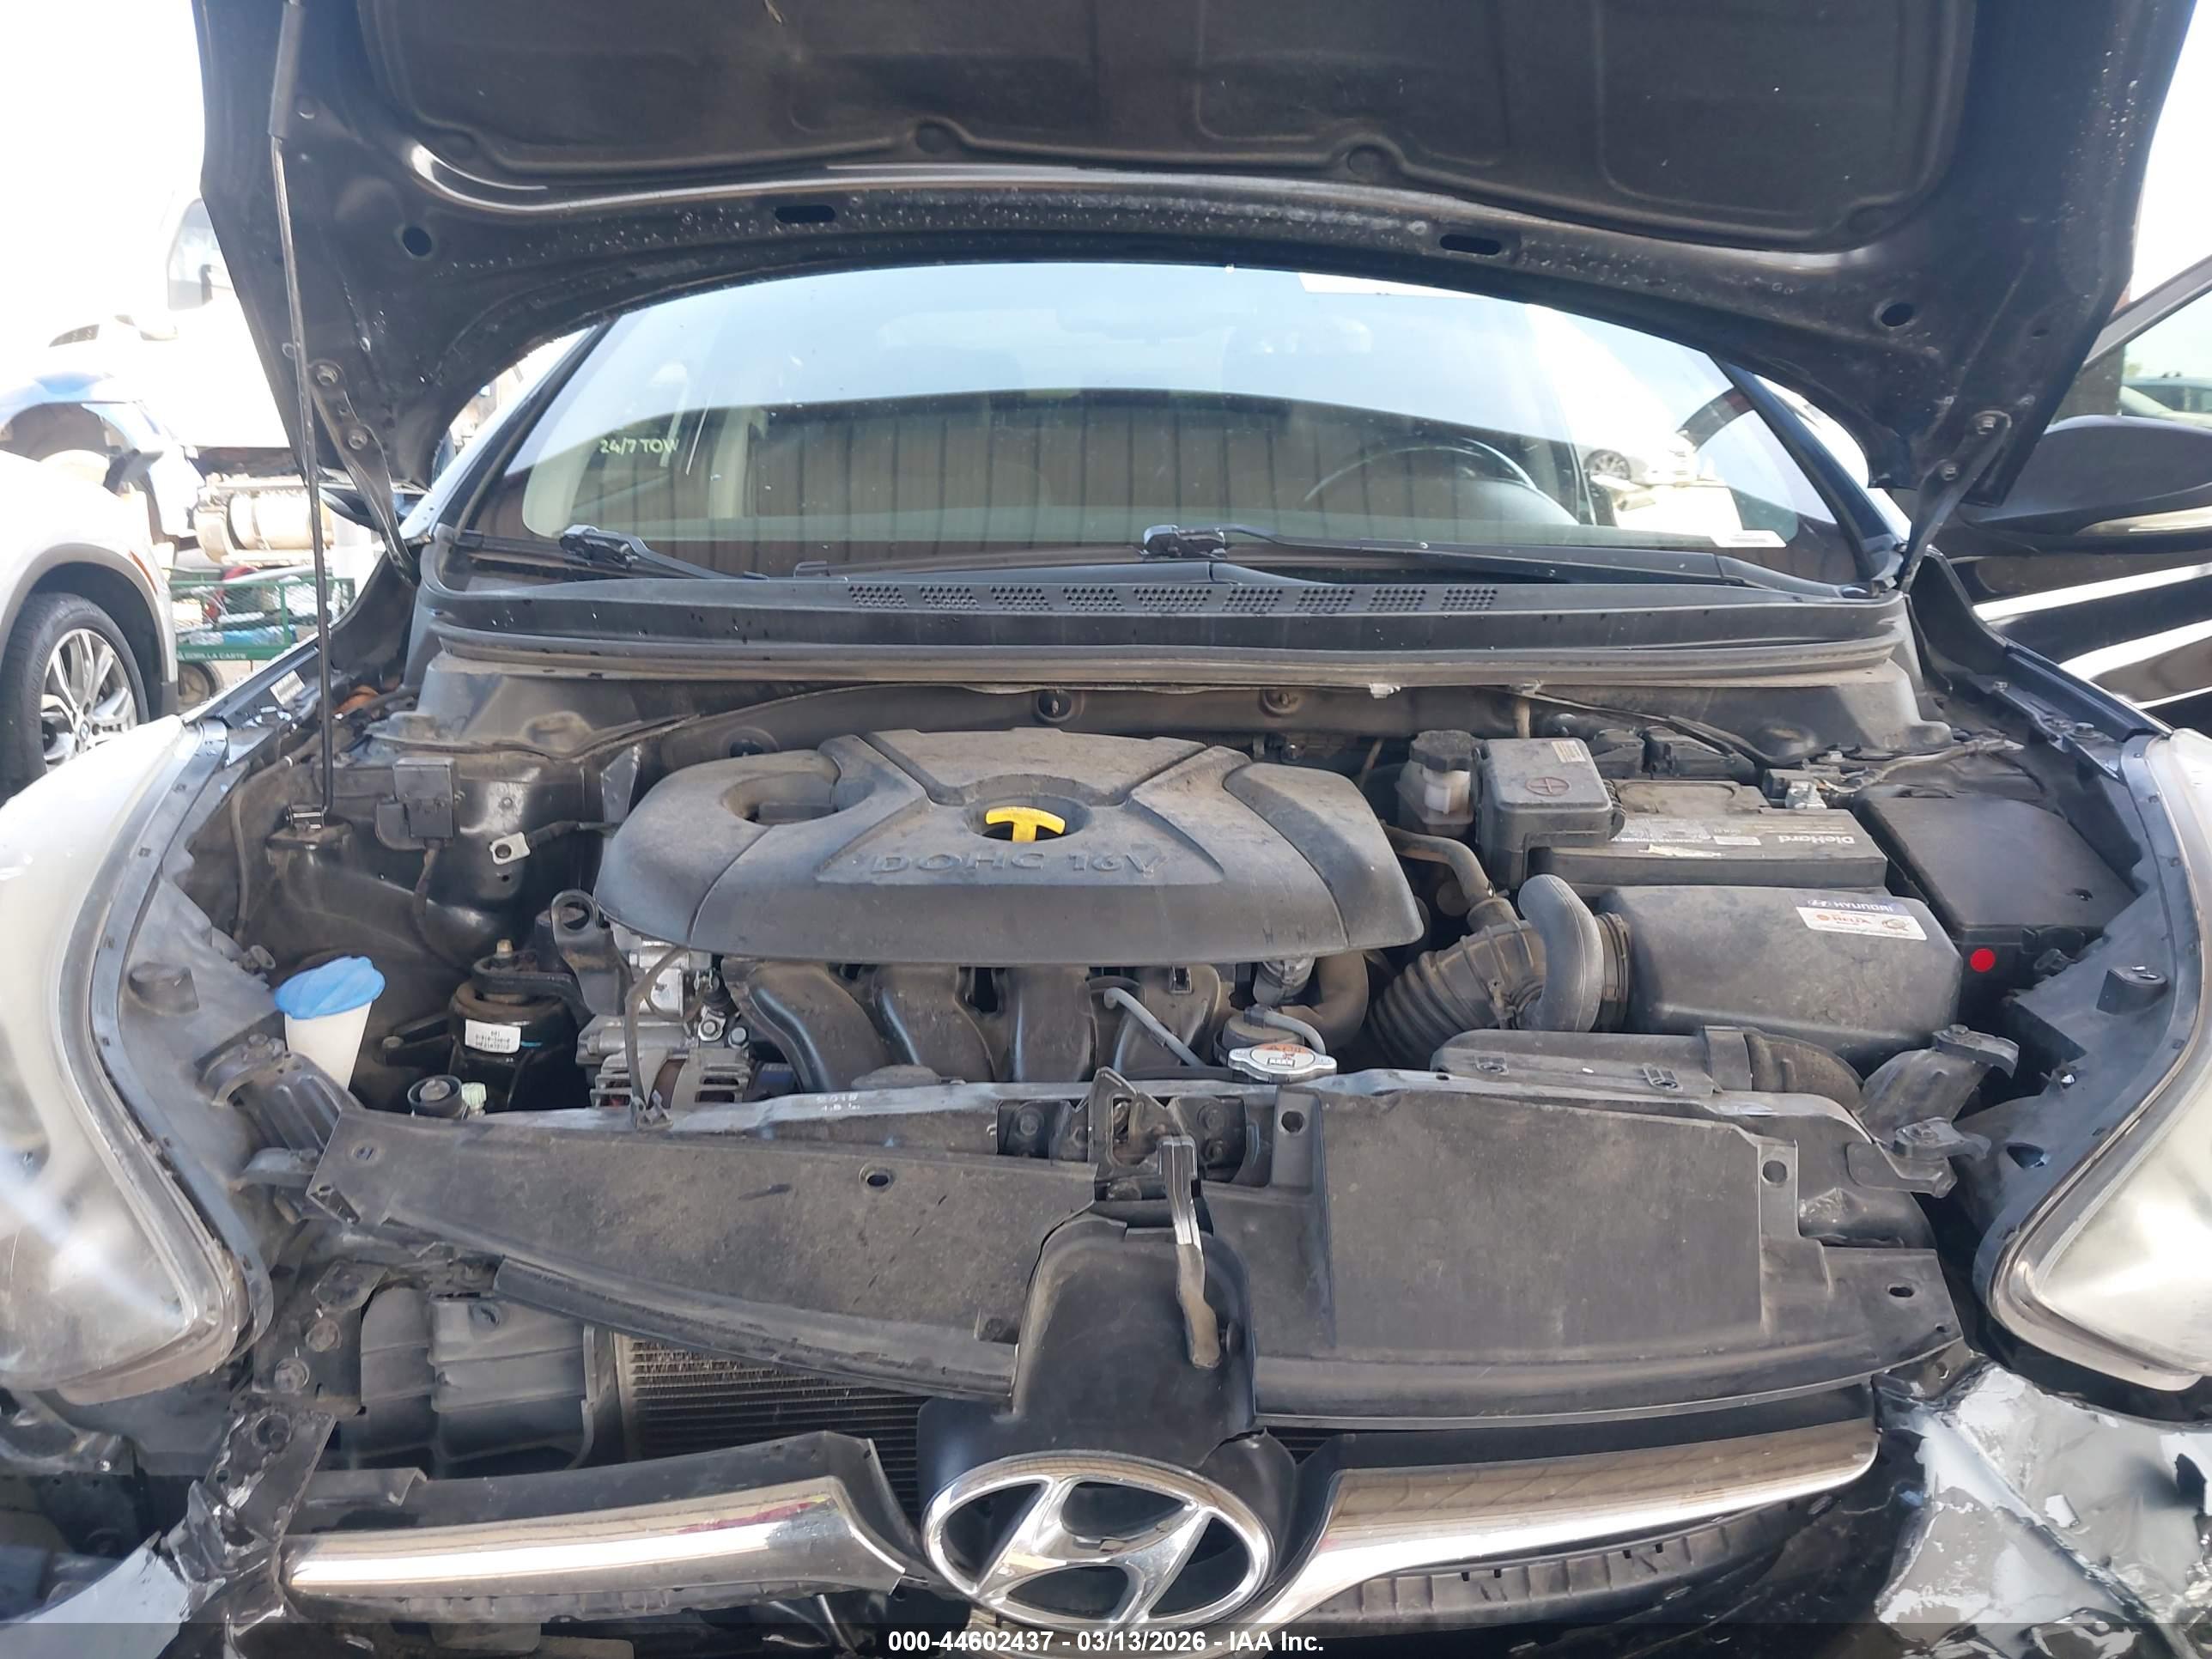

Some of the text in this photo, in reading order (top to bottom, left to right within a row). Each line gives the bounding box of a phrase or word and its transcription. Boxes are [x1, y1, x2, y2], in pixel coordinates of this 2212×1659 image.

[599, 437, 680, 456] 24/7 TOW
[1778, 835, 1855, 845] DieHard
[870, 851, 1166, 876] DOHC 16V
[1833, 901, 1894, 913] HYUNDAI
